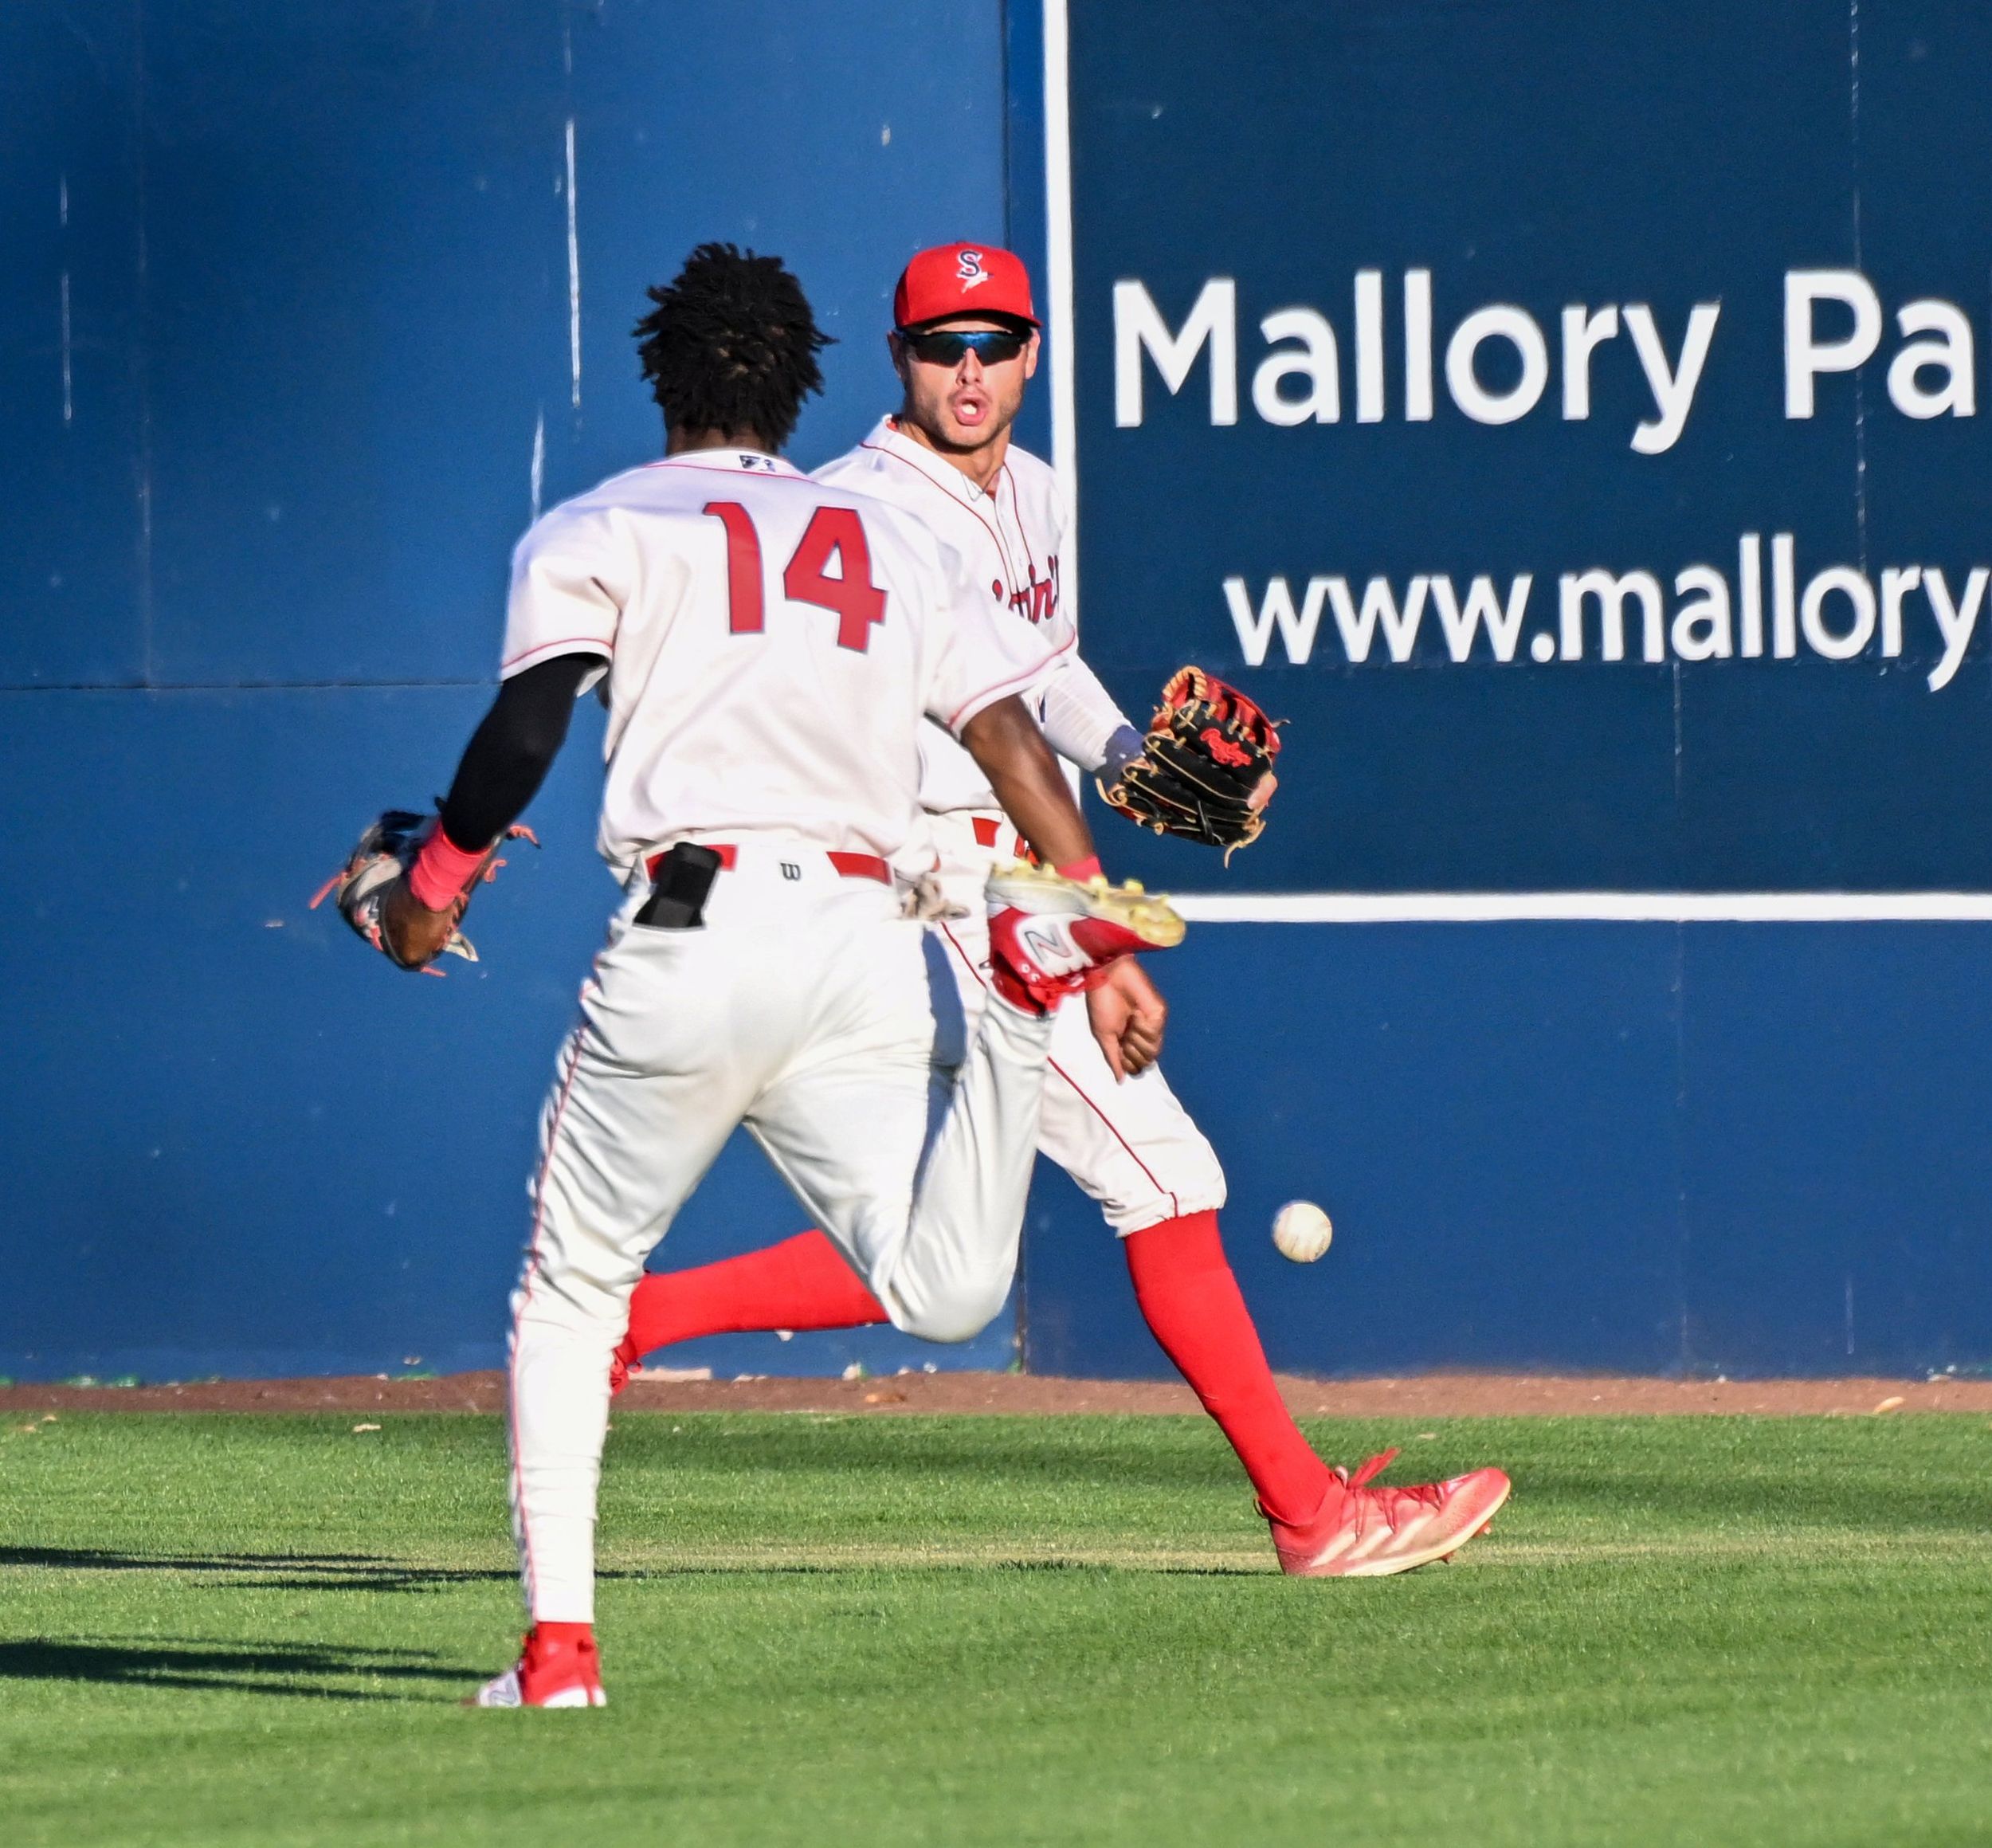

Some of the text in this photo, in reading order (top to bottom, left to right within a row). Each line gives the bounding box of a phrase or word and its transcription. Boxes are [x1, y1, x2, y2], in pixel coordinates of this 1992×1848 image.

[957, 249, 983, 278] S
[1113, 269, 1976, 454] Mallory Pa
[702, 500, 888, 653] 14
[1223, 533, 1990, 693] www.mallory
